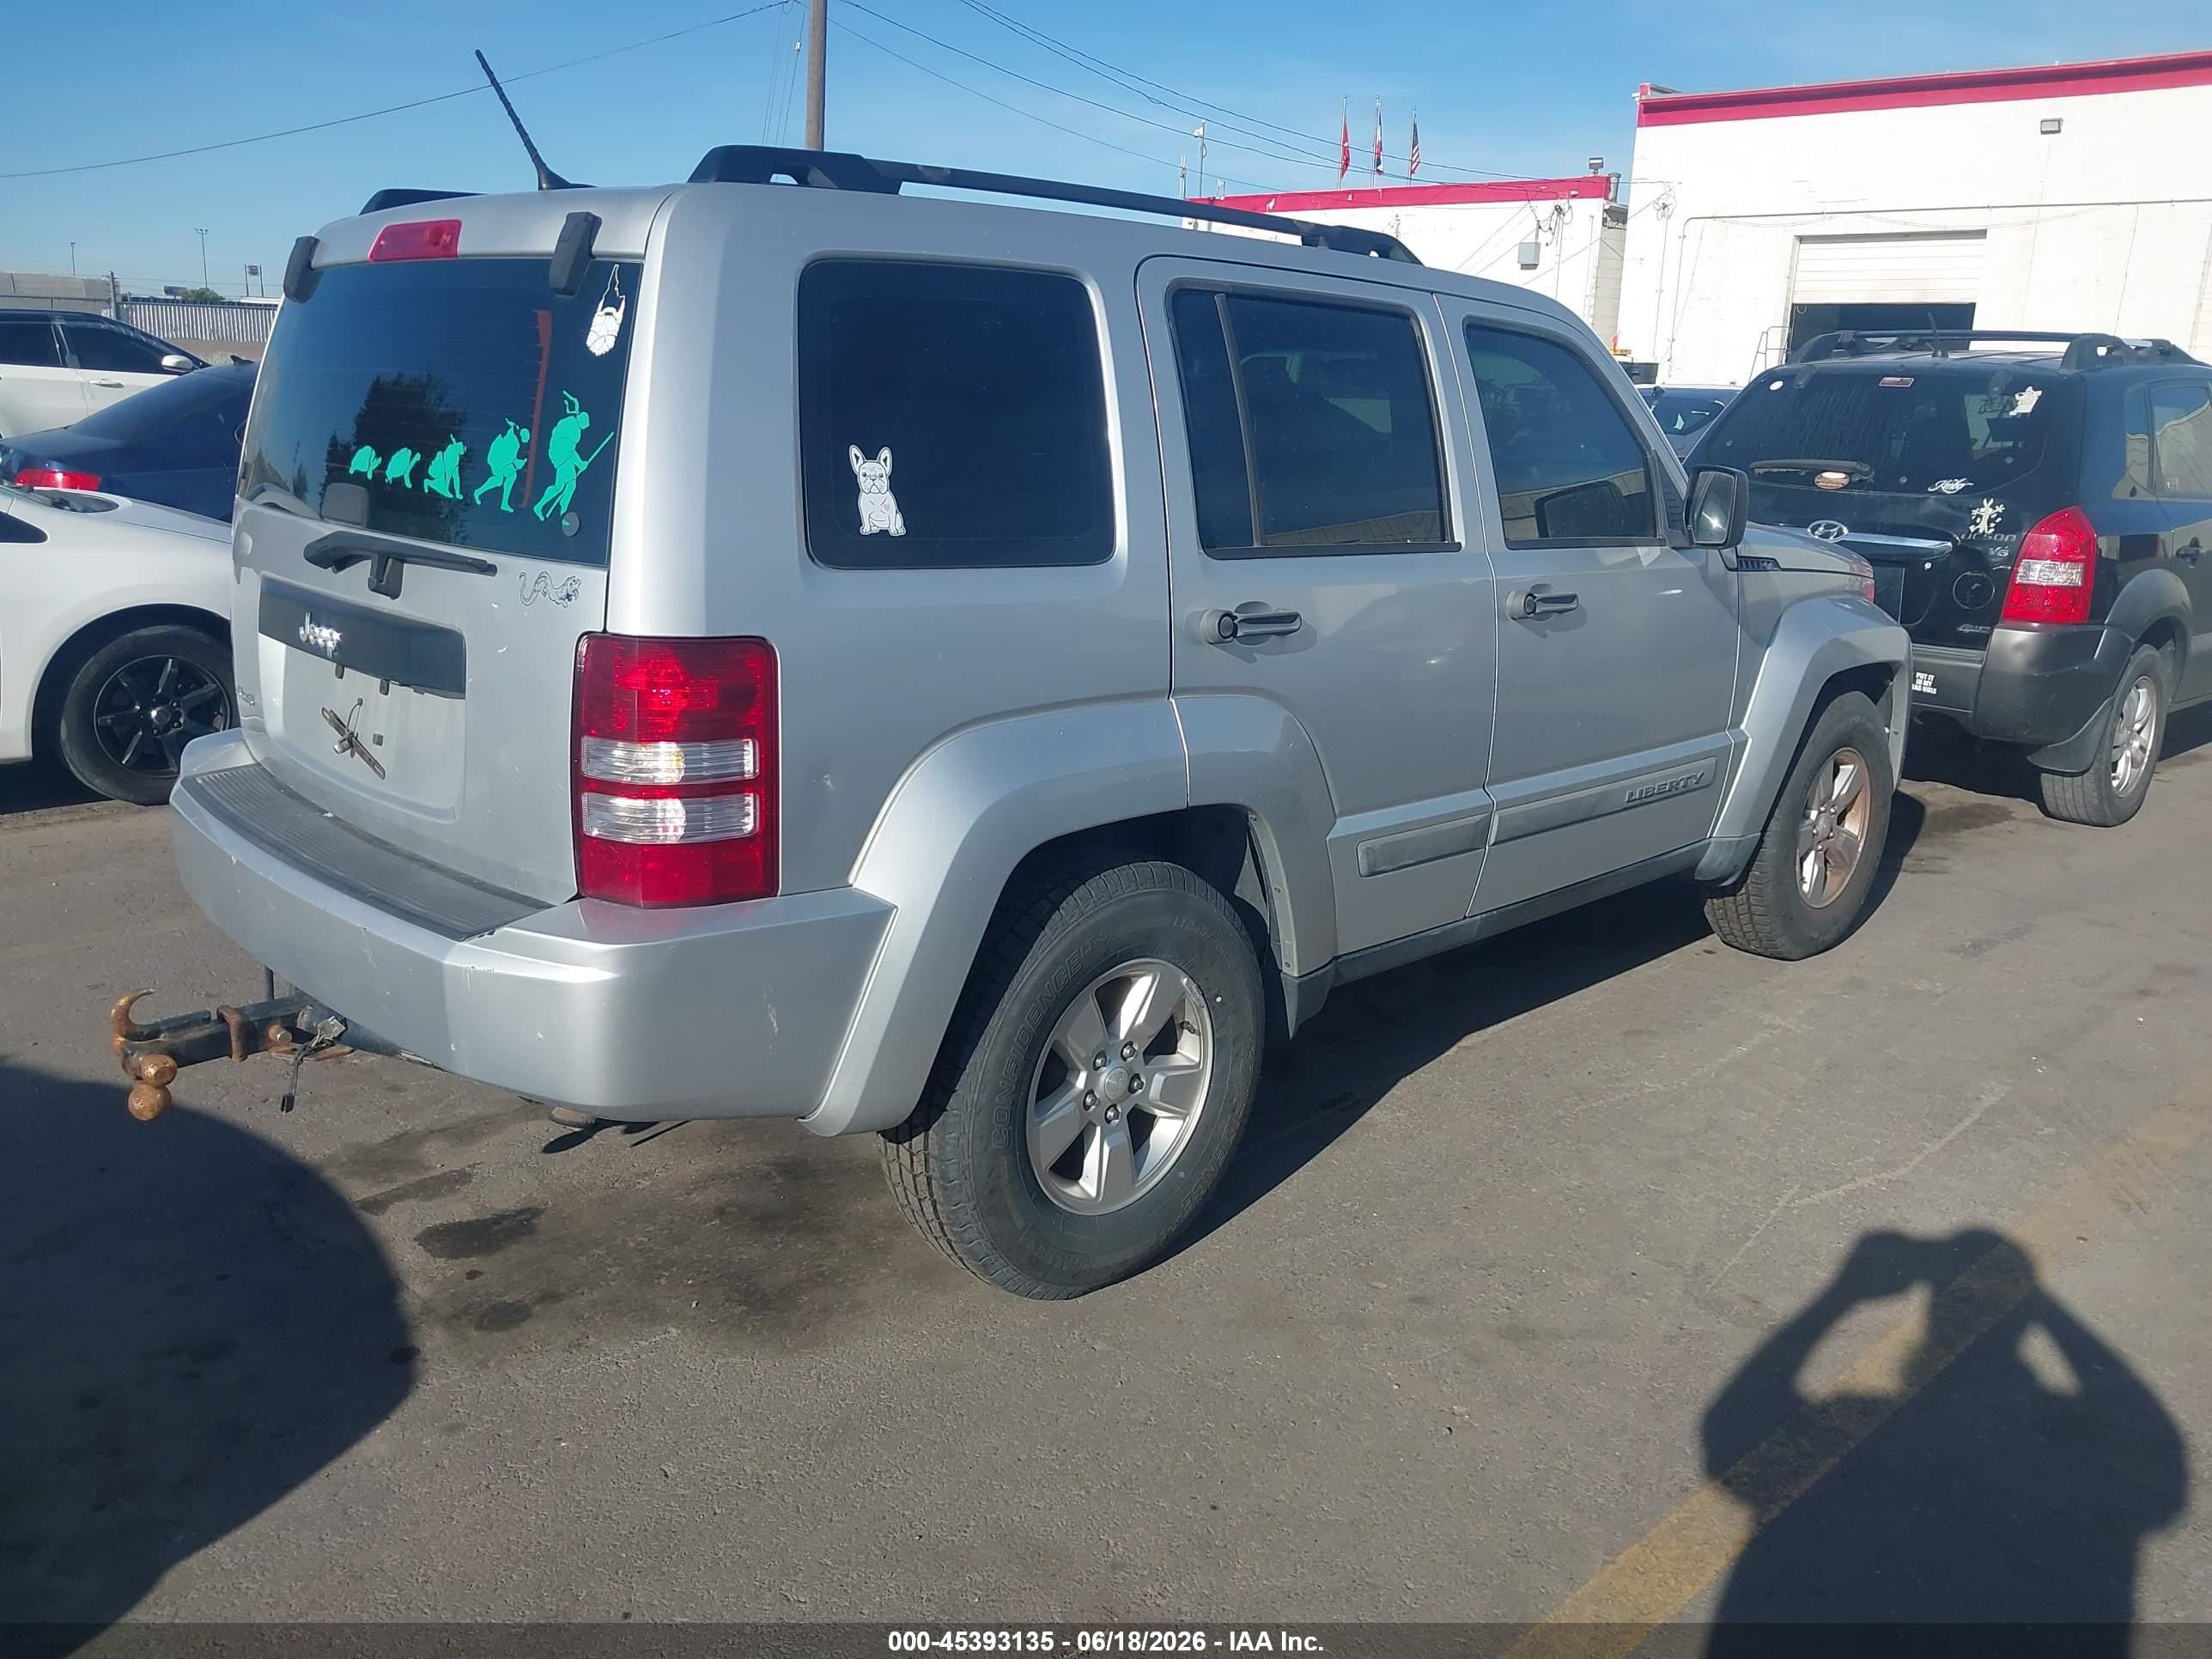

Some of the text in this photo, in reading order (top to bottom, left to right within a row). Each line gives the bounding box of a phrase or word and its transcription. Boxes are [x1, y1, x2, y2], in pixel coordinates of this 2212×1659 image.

[1989, 545, 2009, 556] V6
[299, 611, 343, 659] Jeep
[1916, 672, 1928, 680] PUT
[1625, 770, 1705, 803] LIBERTY
[990, 949, 1084, 1149] CONFIDENCE
